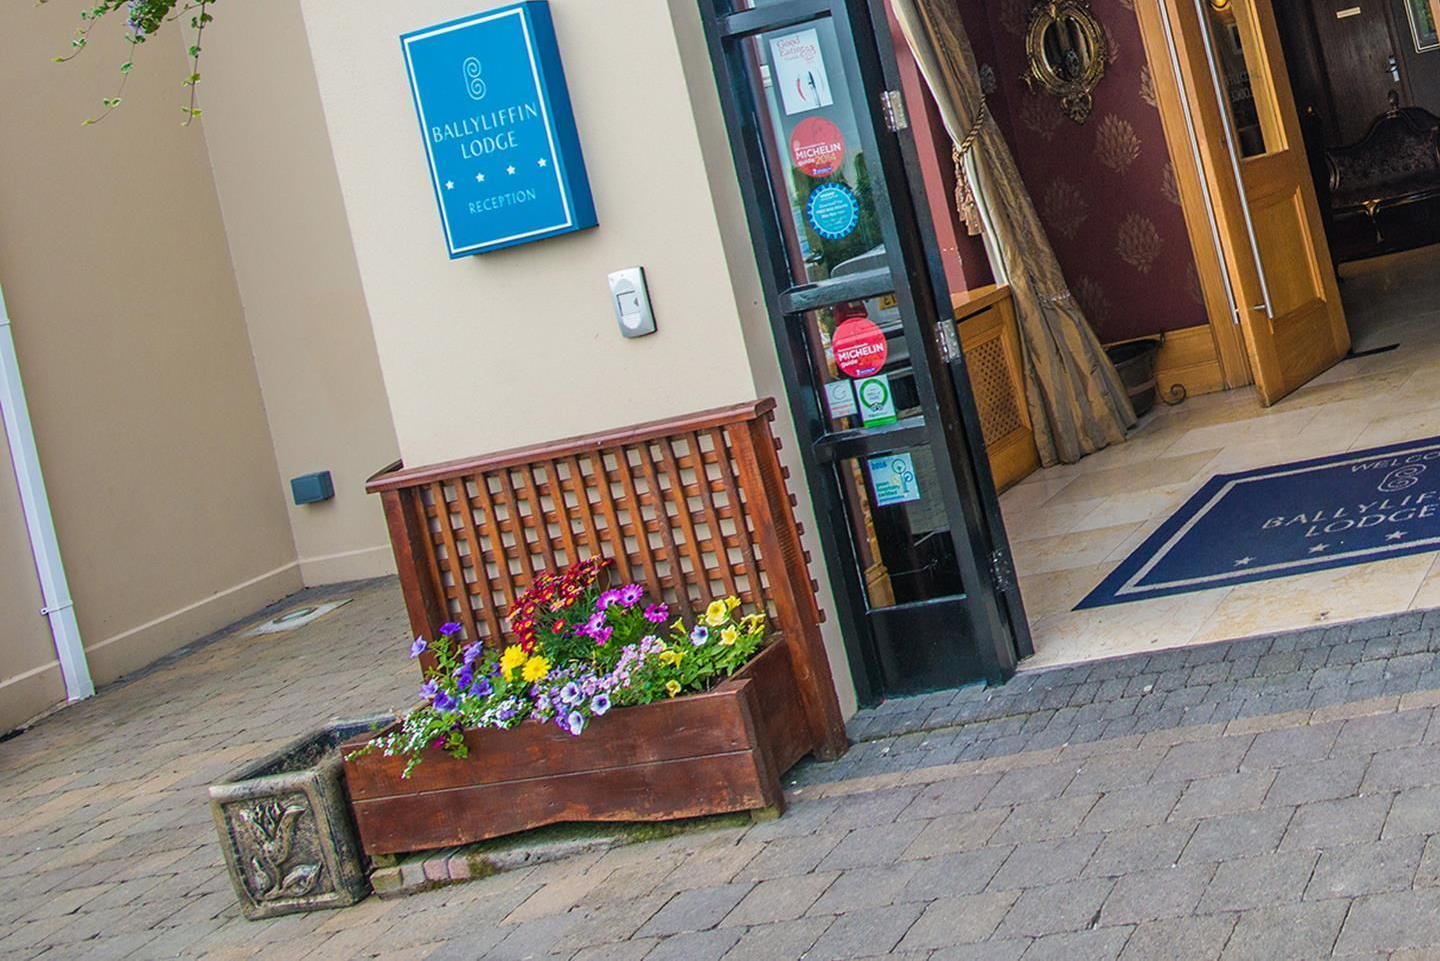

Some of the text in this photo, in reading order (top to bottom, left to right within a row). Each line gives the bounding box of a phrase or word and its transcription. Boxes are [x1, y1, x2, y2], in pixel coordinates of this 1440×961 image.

[431, 102, 538, 143] BALLYLIFFIN
[460, 130, 518, 159] LODGE
[795, 142, 842, 161] MICHELIN
[467, 187, 537, 215] RECEPTION
[838, 342, 884, 361] MICHELIN
[1304, 504, 1439, 539] LODGE
